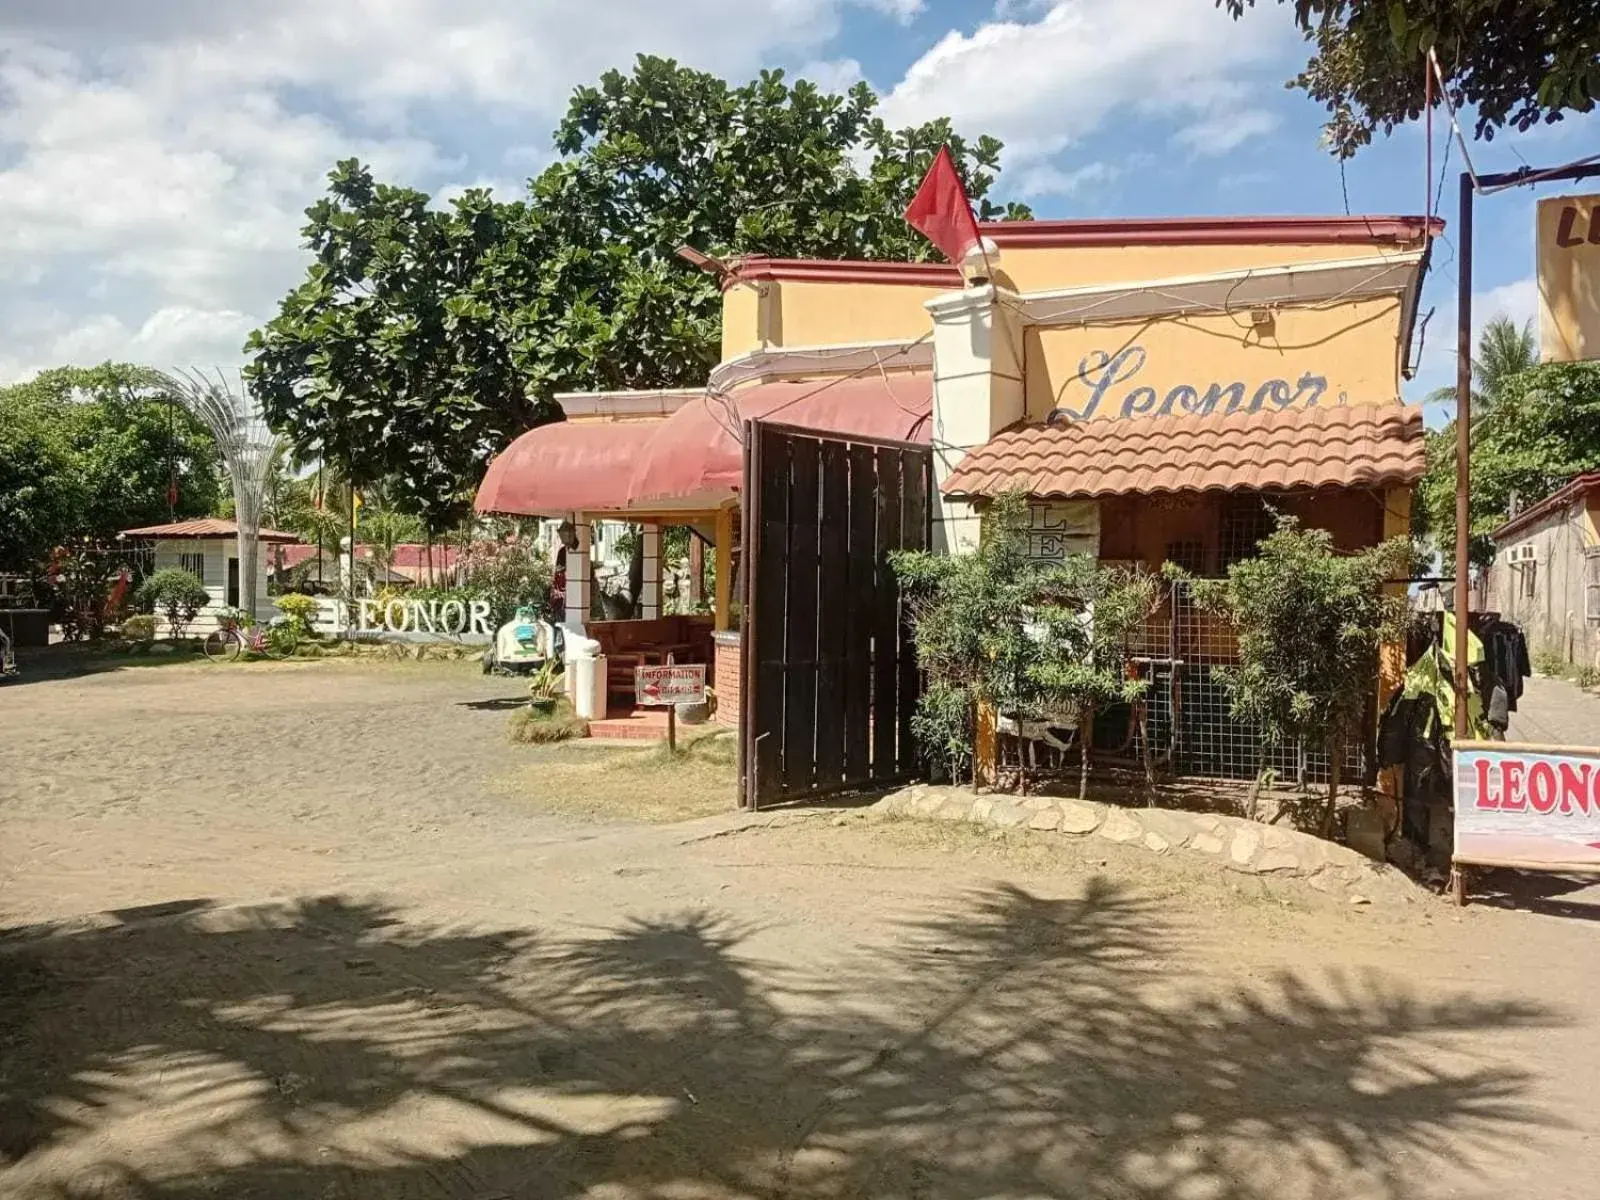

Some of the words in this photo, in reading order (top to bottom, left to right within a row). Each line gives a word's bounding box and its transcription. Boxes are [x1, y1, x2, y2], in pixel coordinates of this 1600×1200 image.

[1048, 346, 1327, 420] Leonor
[641, 669, 701, 680] INFORMATION
[1474, 758, 1600, 815] LEON
